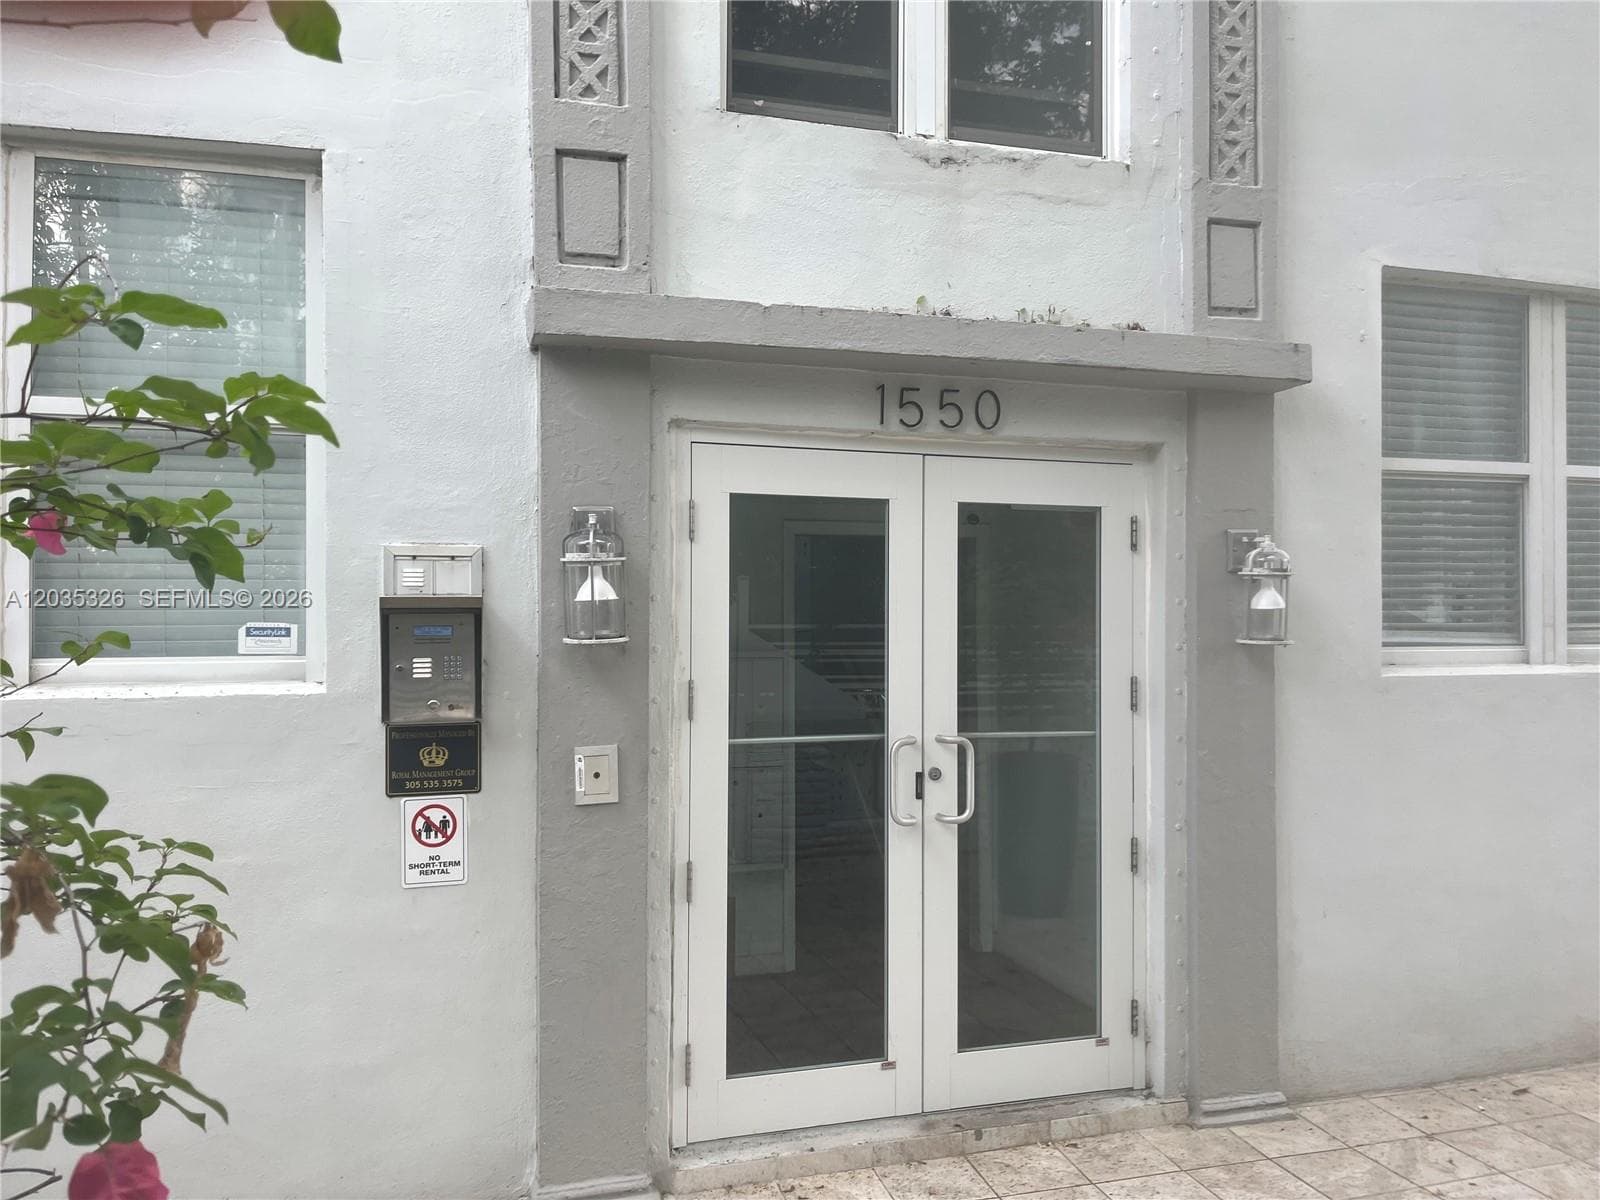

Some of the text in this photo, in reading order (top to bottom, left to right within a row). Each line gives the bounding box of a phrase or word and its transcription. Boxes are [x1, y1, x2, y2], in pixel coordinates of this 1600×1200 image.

[876, 383, 1001, 430] 1550
[391, 768, 476, 780] ROYAL MANAGEMENT GROUP
[428, 854, 441, 862] NO
[408, 860, 461, 870] SHORT-TERM
[419, 868, 450, 876] RENTAL
